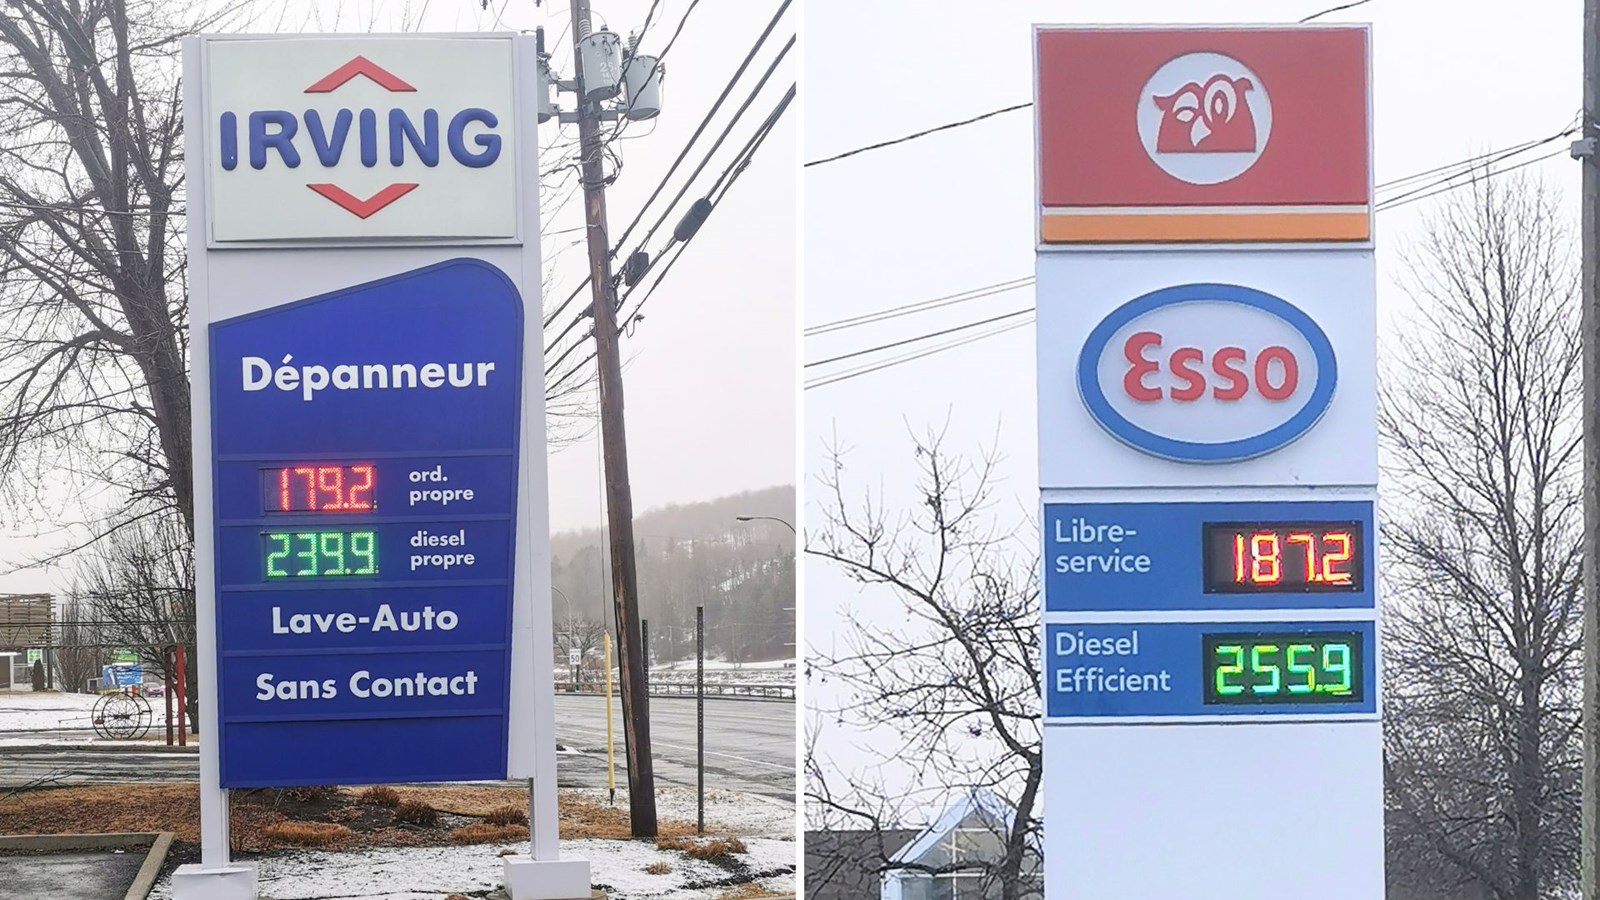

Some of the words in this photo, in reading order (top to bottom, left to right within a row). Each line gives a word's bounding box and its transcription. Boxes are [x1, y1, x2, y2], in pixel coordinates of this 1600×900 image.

[220, 107, 502, 171] IRVING
[242, 353, 495, 401] Dépanneur
[1123, 331, 1299, 403] Esso
[409, 465, 448, 483] ord.
[280, 466, 374, 511] 179.2
[409, 487, 474, 505] propre
[410, 530, 465, 547] diesel
[1055, 518, 1137, 543] Libre-
[266, 532, 375, 577] 239.9
[410, 551, 475, 571] propre
[1055, 548, 1151, 573] service
[1232, 531, 1352, 585] 187.2
[272, 604, 459, 634] Lave-Auto
[1055, 630, 1139, 656] Diesel
[571, 654, 580, 663] 50
[1214, 643, 1352, 695] 255.9
[256, 672, 338, 701] Sans
[349, 670, 478, 698] Contact
[1056, 667, 1171, 692] Efficient
